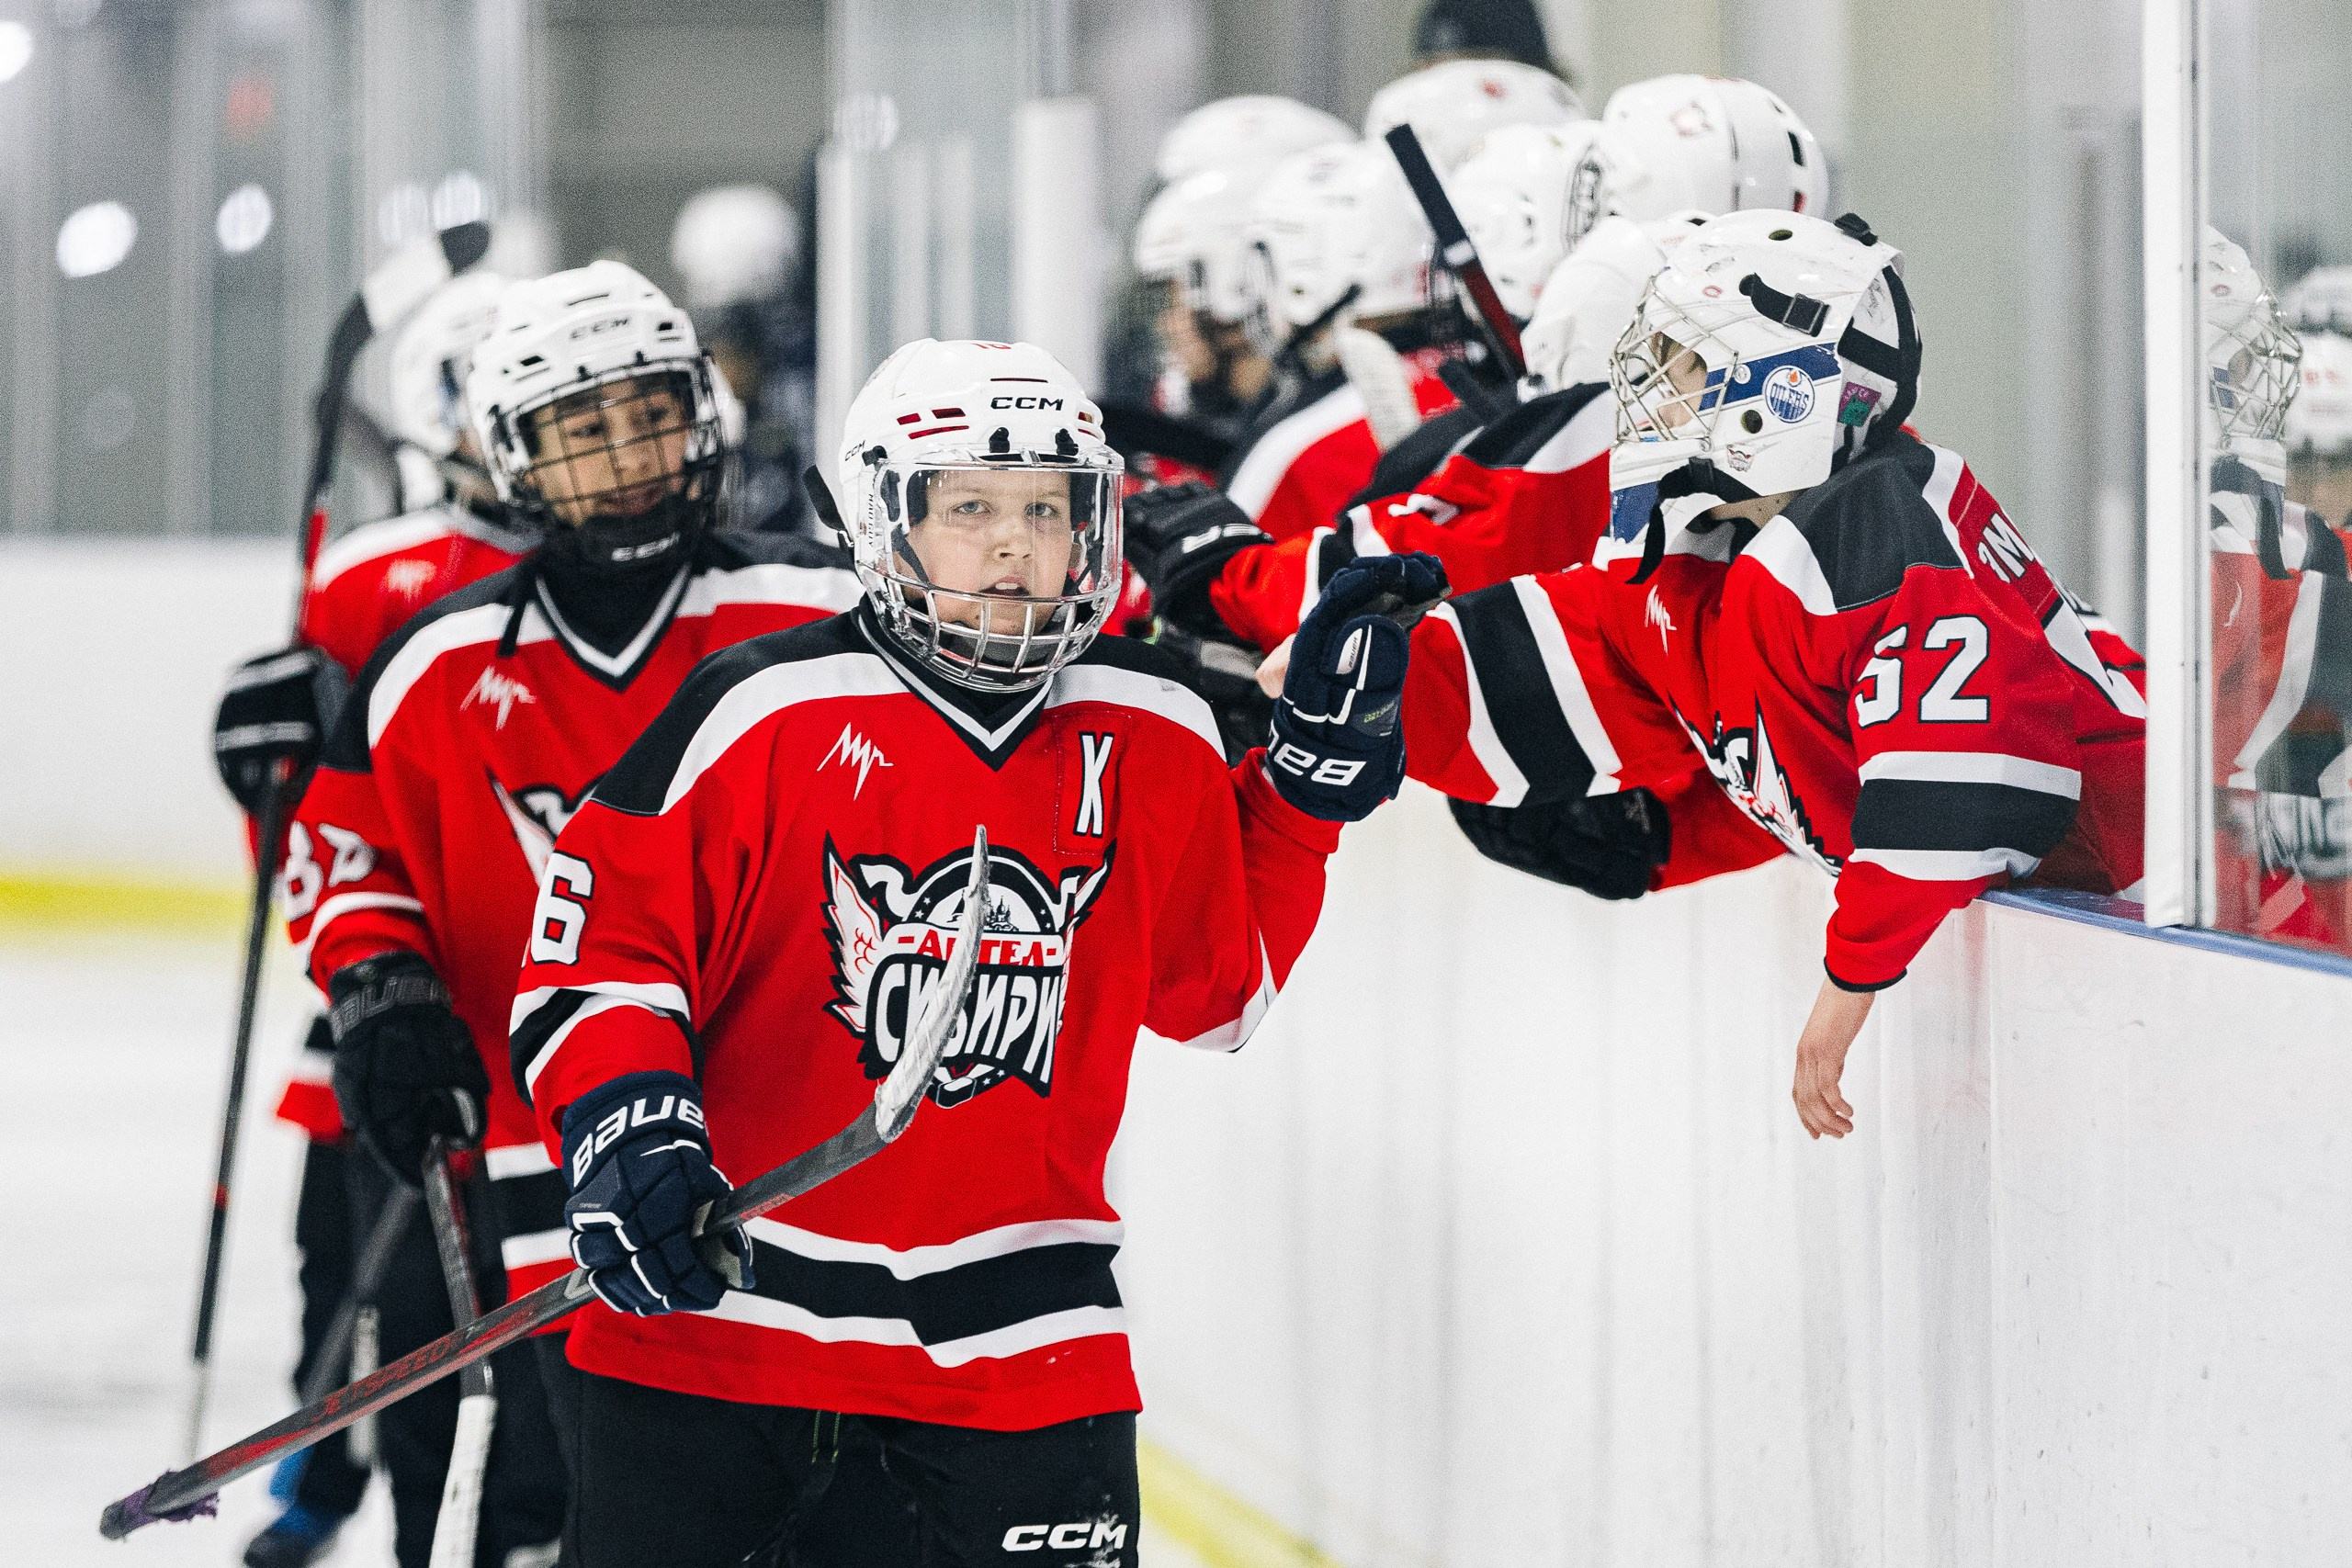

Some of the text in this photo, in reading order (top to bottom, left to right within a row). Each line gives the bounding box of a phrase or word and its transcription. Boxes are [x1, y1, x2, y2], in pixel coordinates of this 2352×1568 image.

[989, 396, 1064, 412] CCM
[1770, 382, 1809, 421] OILERS
[843, 439, 865, 462] CCM
[1854, 614, 1991, 730] 52
[521, 850, 595, 970] 6
[1001, 1522, 1128, 1552] CCM
